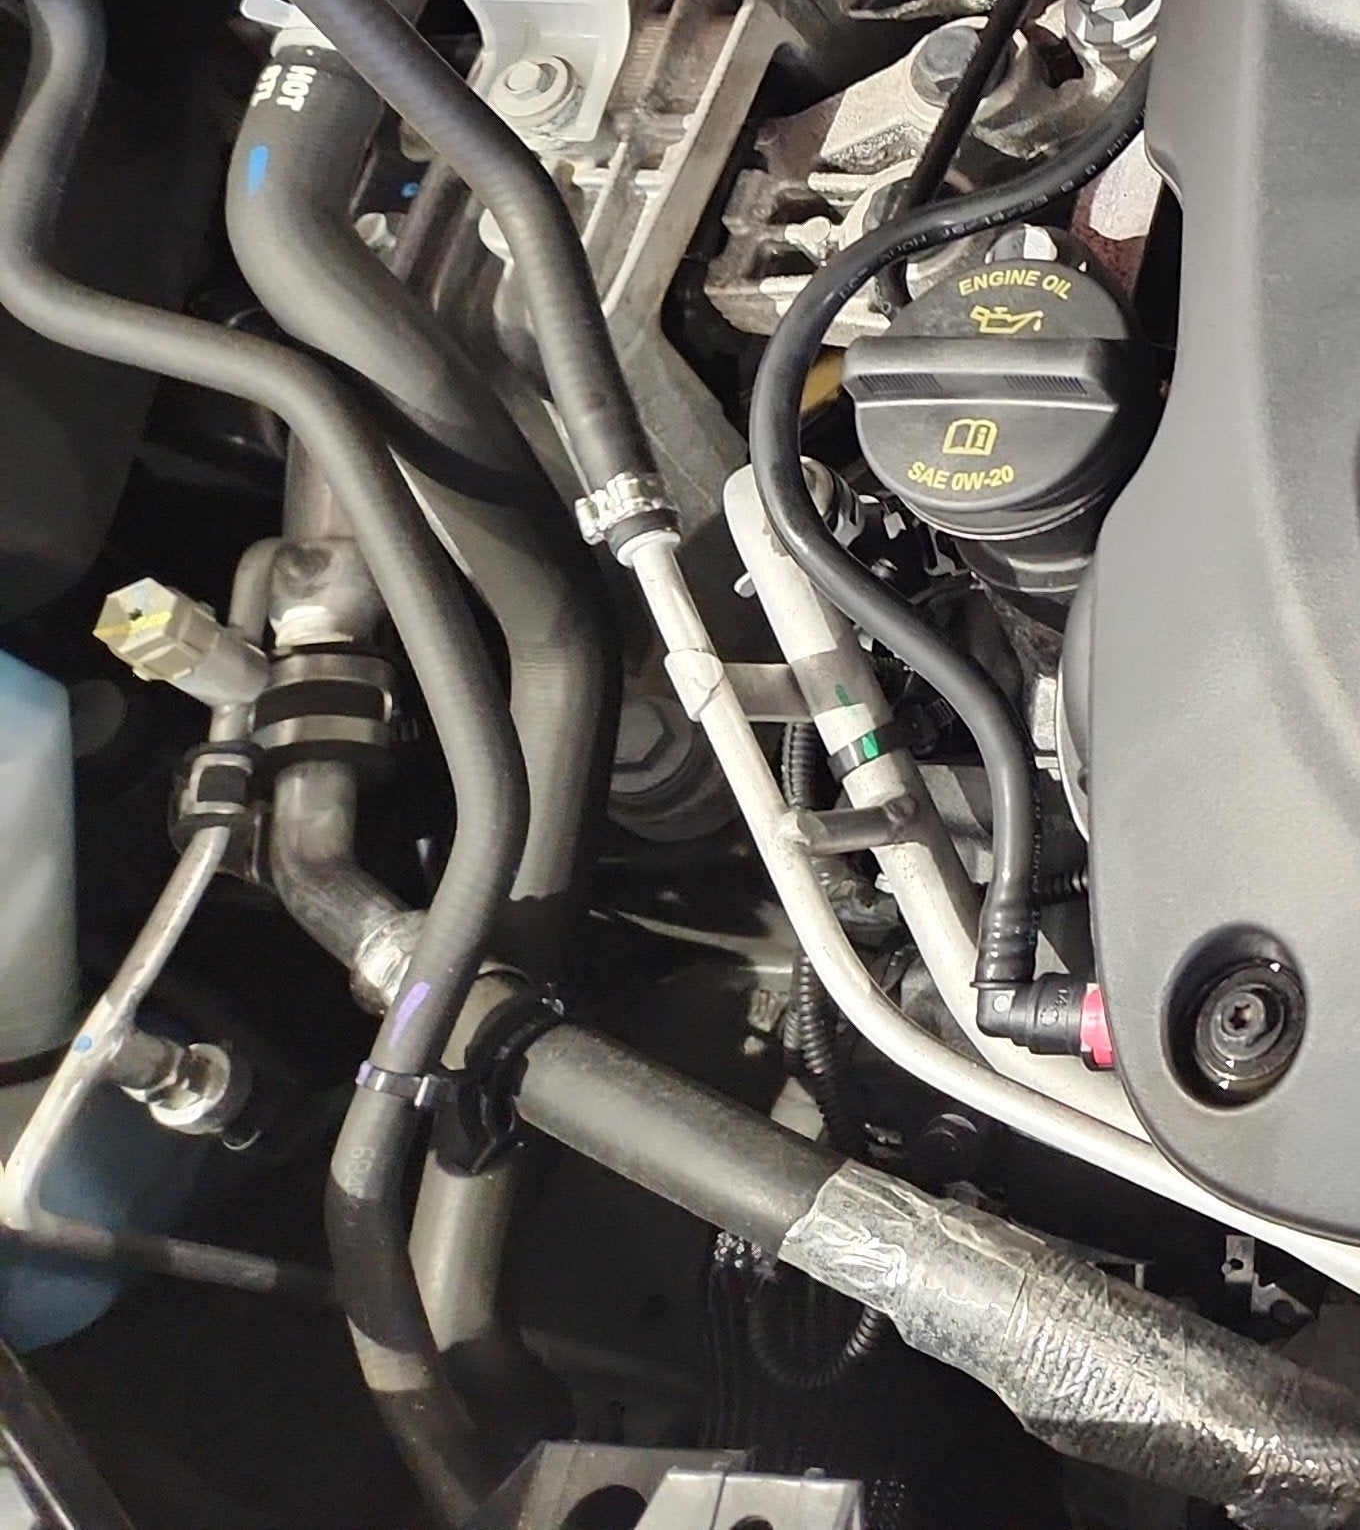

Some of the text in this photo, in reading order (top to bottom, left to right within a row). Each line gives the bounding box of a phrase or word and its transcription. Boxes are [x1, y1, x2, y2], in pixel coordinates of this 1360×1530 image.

[276, 65, 318, 112] HOT
[958, 269, 1072, 300] ENGINE OIL
[907, 460, 1014, 491] SAE 0W-20
